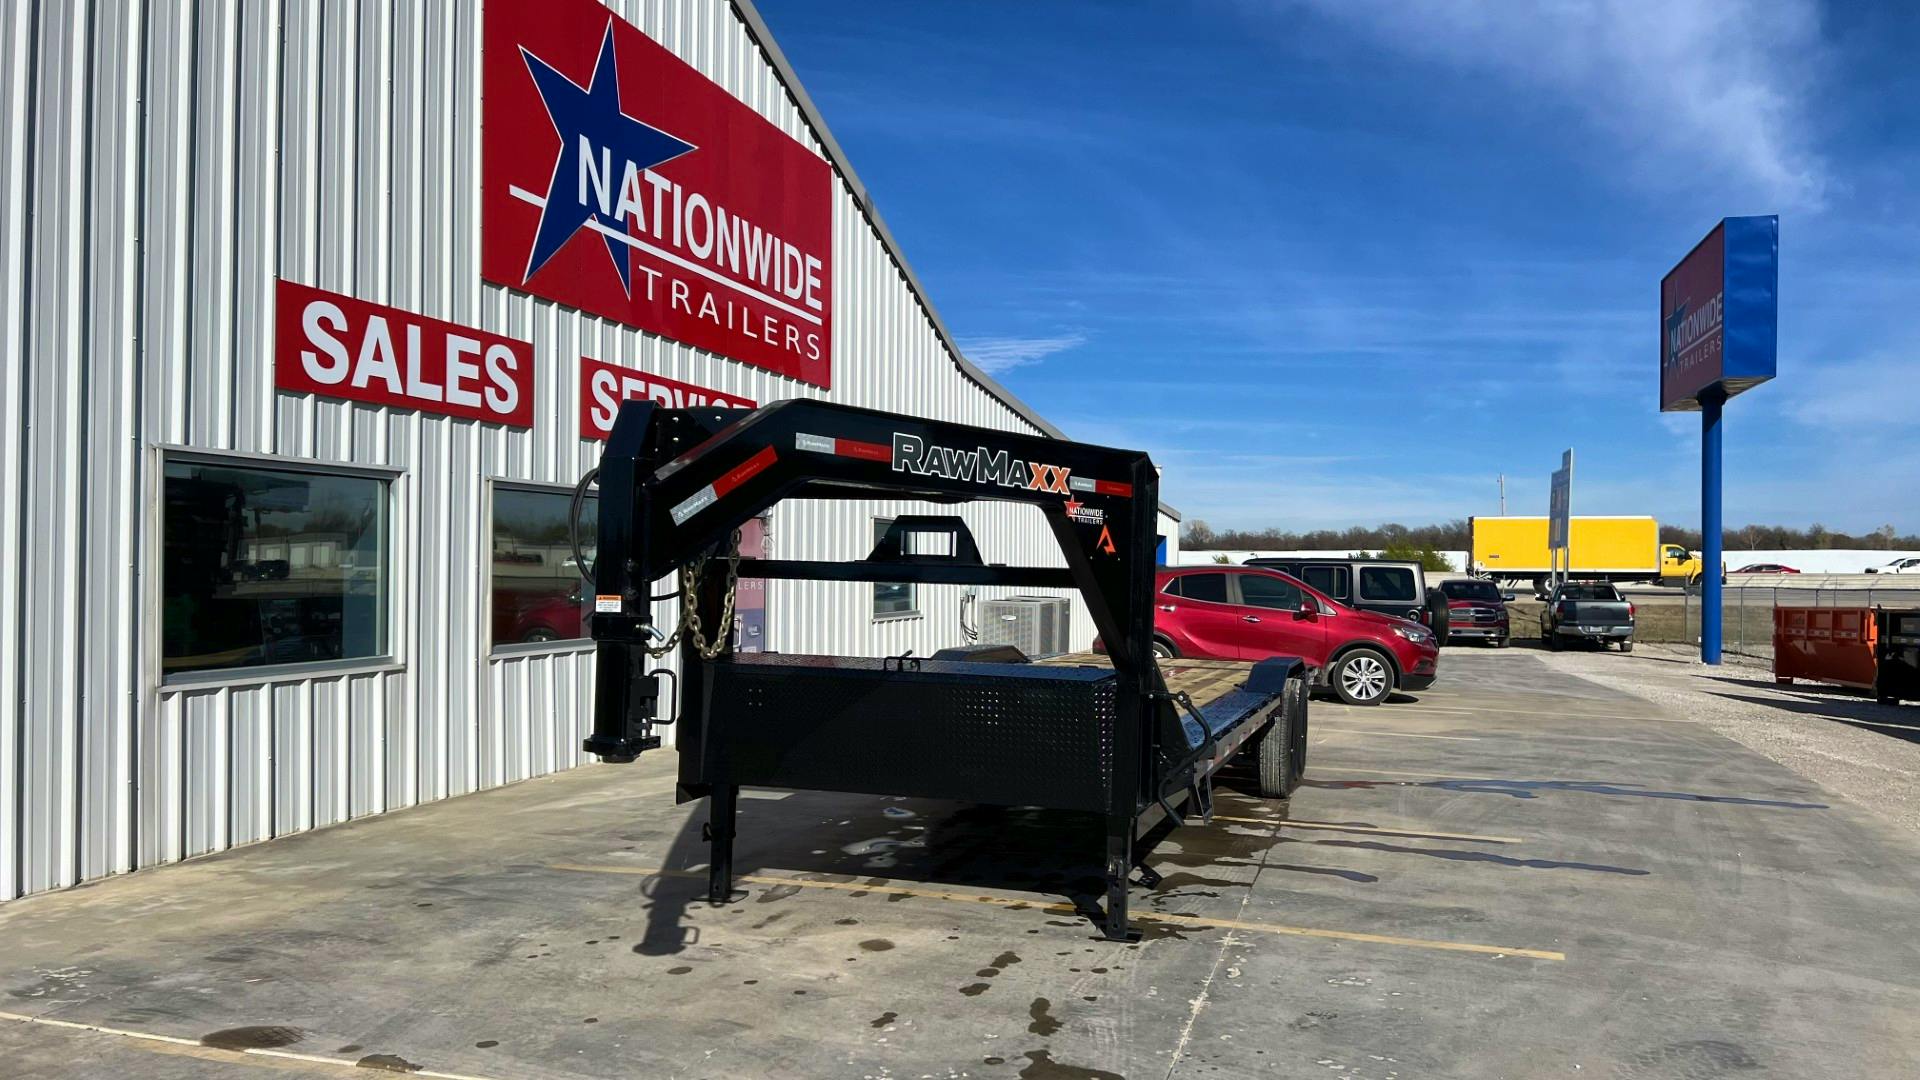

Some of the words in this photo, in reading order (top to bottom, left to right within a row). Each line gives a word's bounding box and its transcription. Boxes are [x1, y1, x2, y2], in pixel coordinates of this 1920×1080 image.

[578, 133, 823, 312] NATIONWIDE
[638, 264, 821, 361] TRAILERS
[1670, 291, 1722, 353] NATIONWIDE
[300, 300, 520, 415] SALES
[1679, 334, 1722, 374] TRAILERS
[1069, 507, 1103, 517] NATIONWIDE
